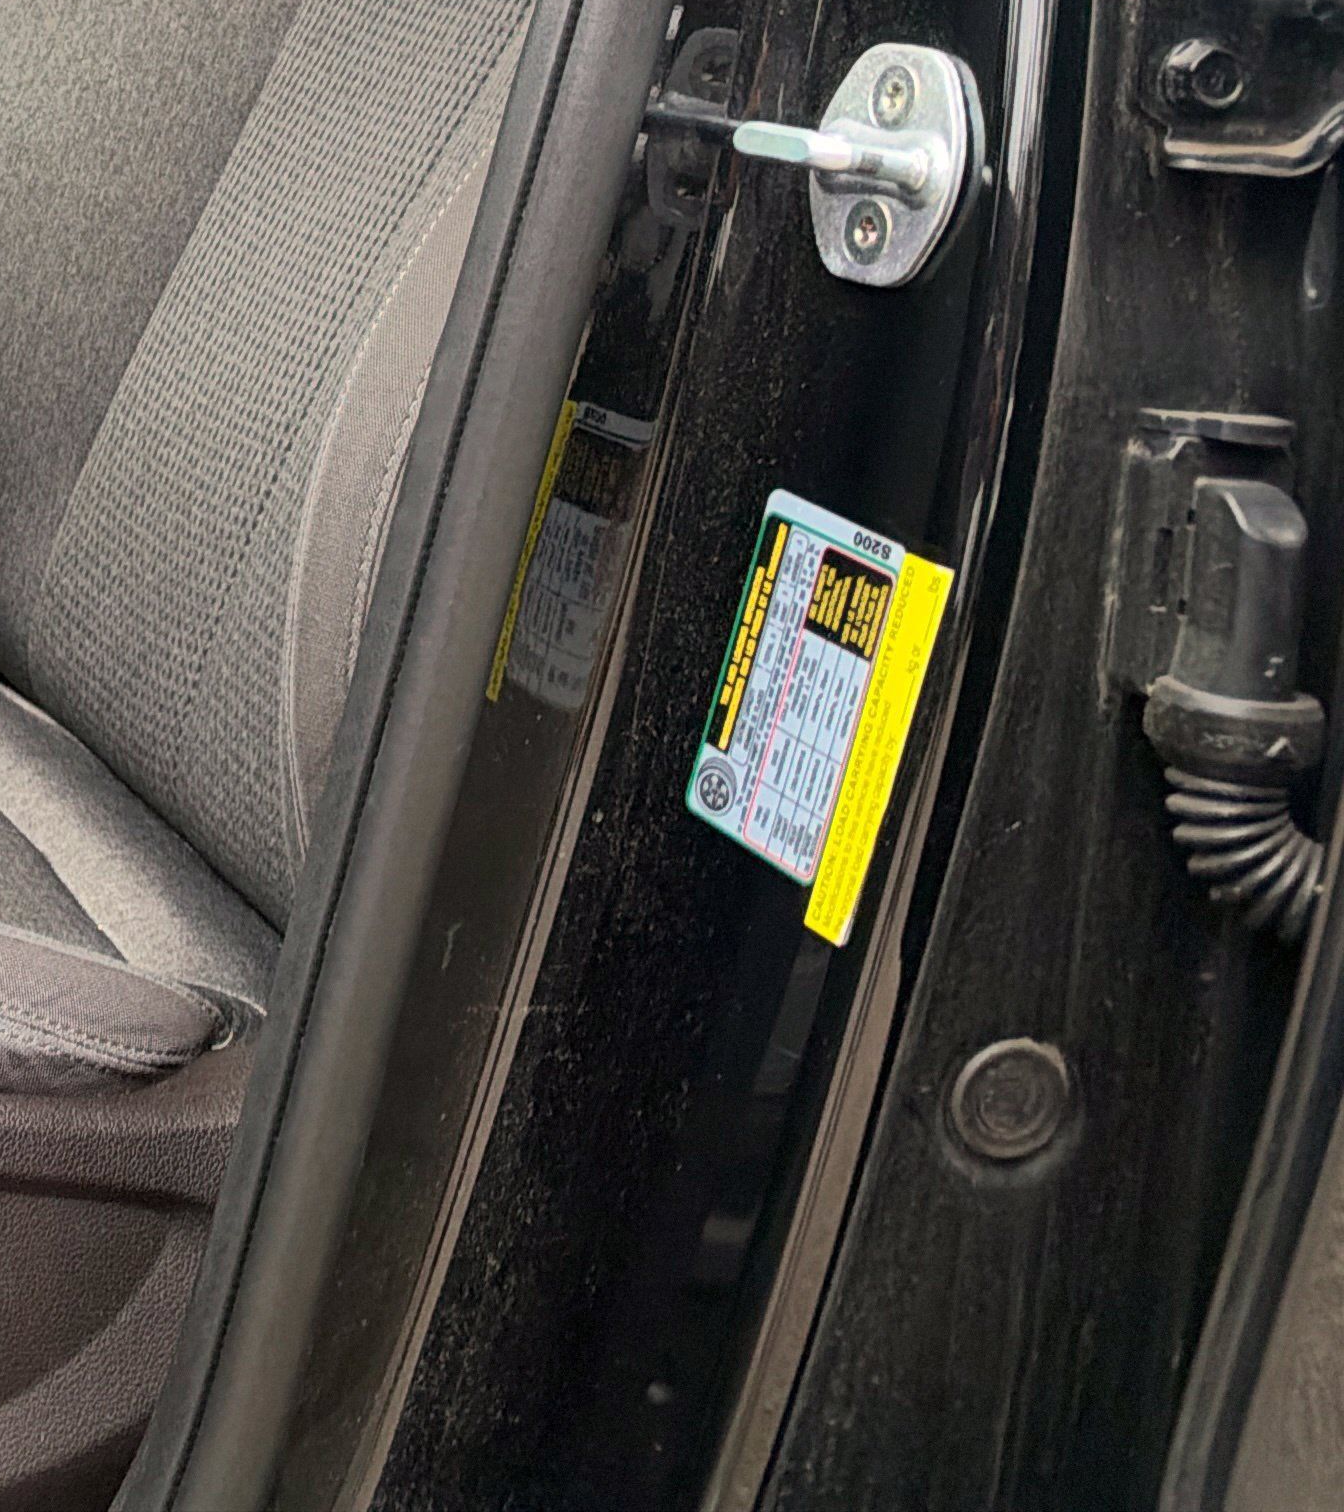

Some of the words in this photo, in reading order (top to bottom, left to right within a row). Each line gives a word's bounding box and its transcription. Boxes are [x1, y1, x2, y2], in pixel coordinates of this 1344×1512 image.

[833, 805, 850, 845] LOAD
[846, 723, 873, 800] CARRYING
[868, 647, 894, 718] CAPACITY
[889, 566, 914, 638] REDUCED
